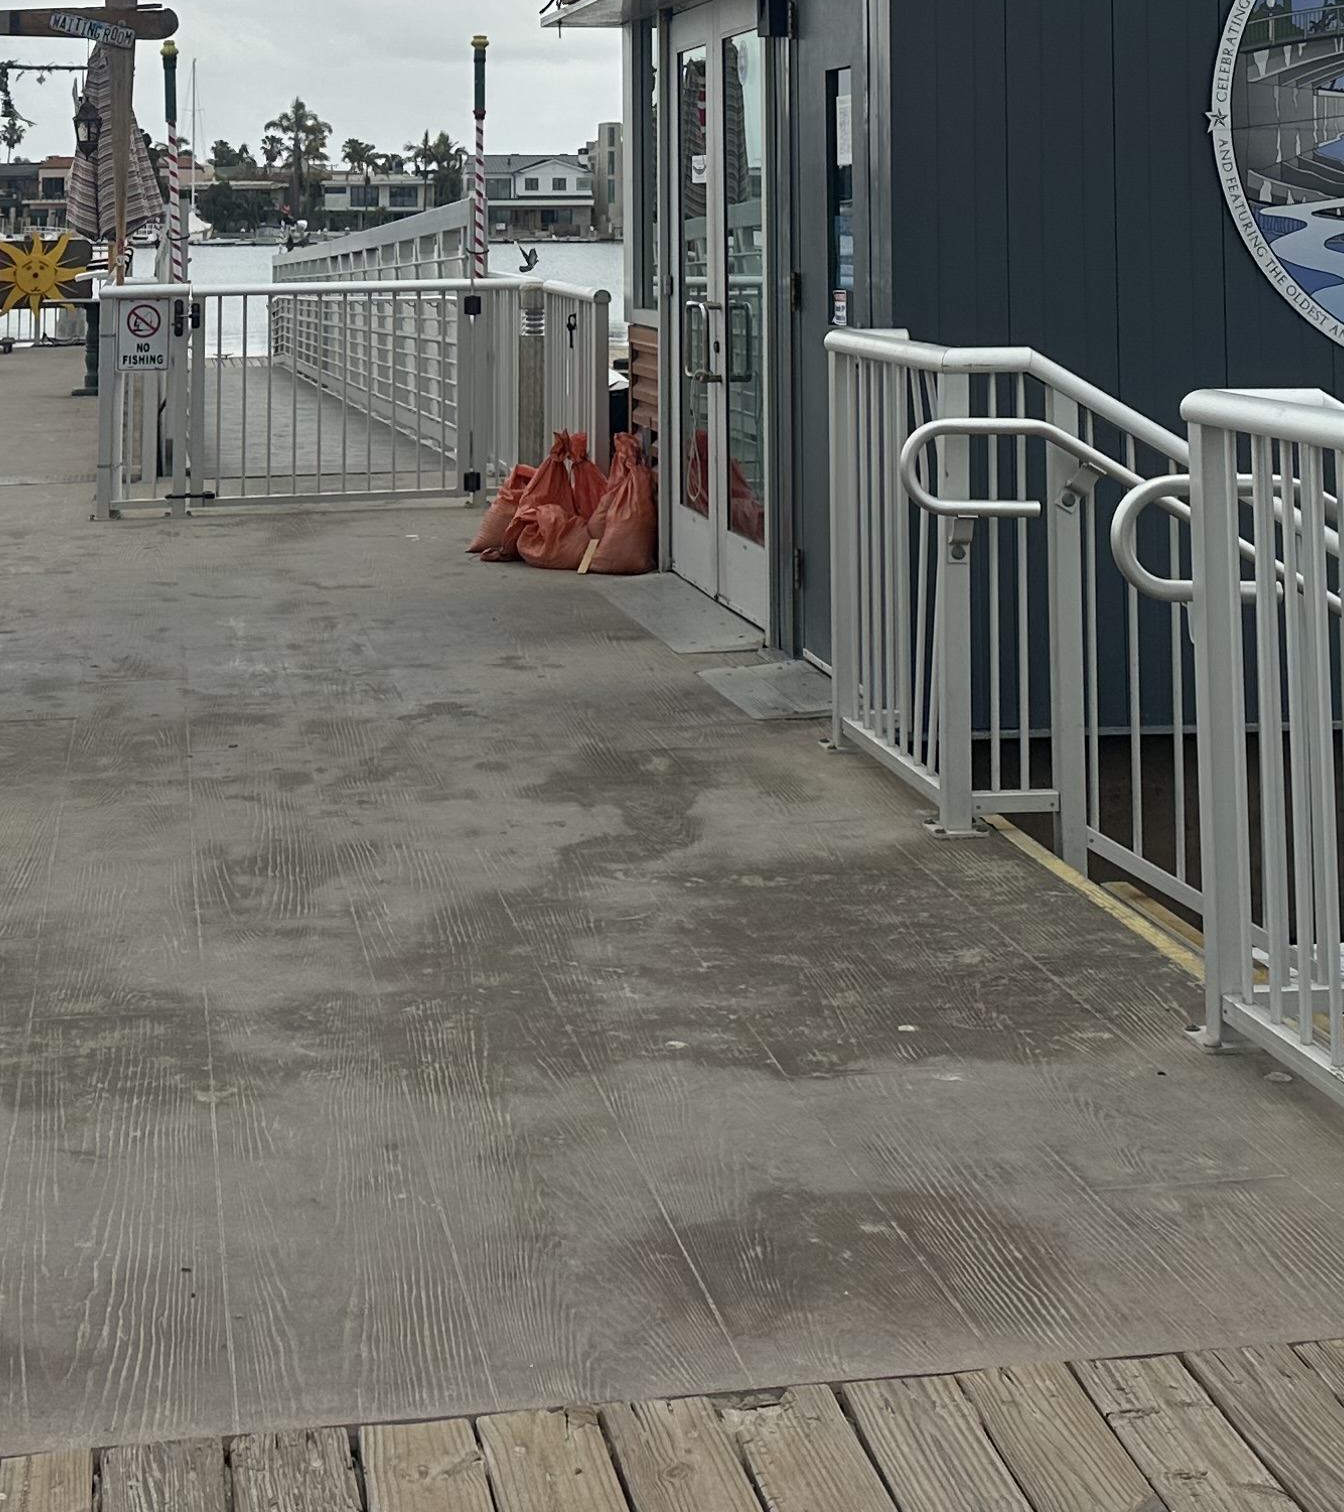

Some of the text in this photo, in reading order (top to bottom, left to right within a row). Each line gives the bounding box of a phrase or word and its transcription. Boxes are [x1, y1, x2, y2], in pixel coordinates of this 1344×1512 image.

[51, 12, 134, 48] WAITING ROOM
[1218, 138, 1233, 172] AND
[1226, 176, 1268, 258] FEATURING
[1265, 258, 1288, 286] THE
[1285, 285, 1330, 326] OLDEST
[122, 354, 164, 366] FISHING
[136, 343, 151, 353] NO
